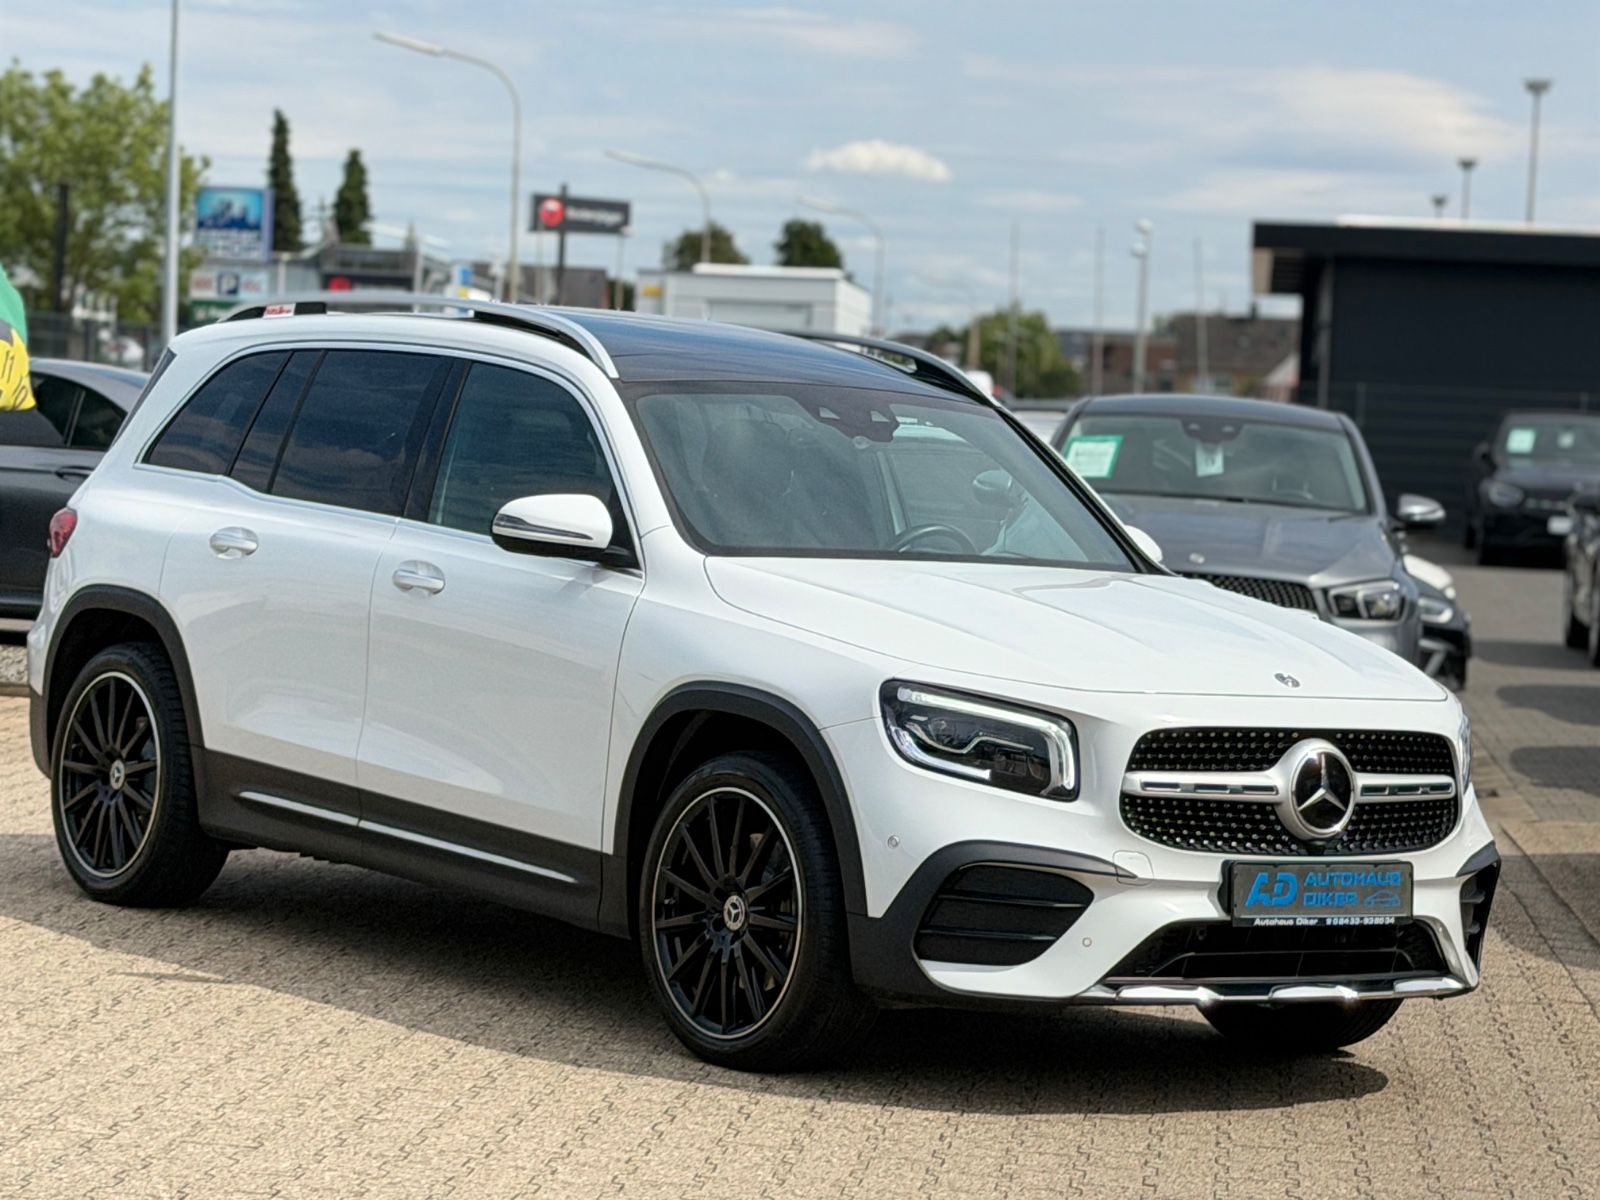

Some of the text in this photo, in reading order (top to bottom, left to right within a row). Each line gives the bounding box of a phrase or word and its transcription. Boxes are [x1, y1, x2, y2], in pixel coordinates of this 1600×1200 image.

[1303, 871, 1403, 887] AUTOHAUS
[1303, 892, 1358, 907] DIKER
[1253, 917, 1294, 927] Autohaus
